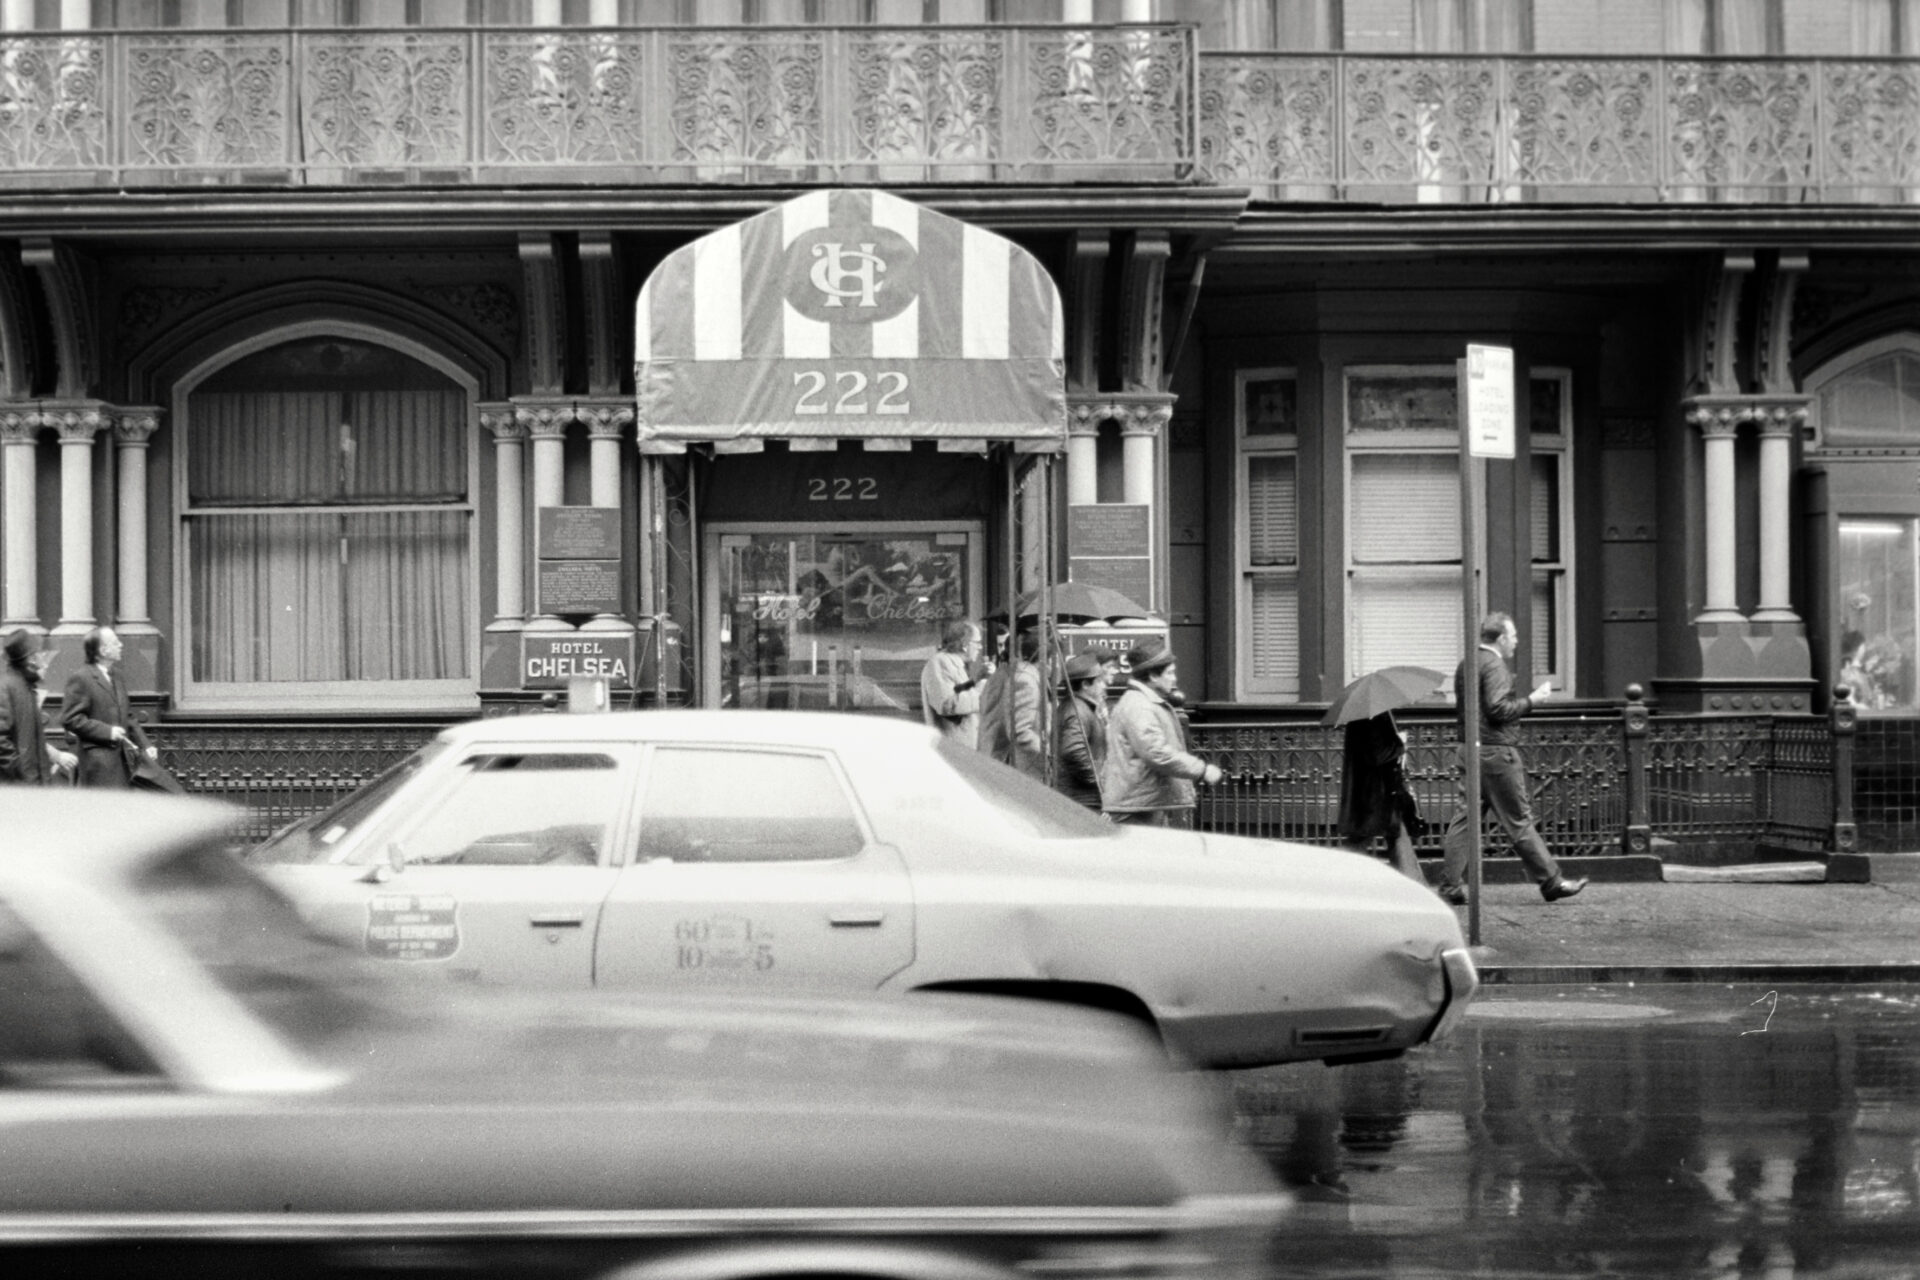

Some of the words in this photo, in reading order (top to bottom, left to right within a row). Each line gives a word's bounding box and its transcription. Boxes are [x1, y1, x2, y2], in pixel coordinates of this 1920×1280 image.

[793, 370, 911, 415] 222
[808, 478, 879, 500] 222
[753, 596, 821, 620] Hotel
[866, 595, 946, 619] Chelsea
[551, 642, 604, 654] HOTEL
[527, 657, 627, 678] CHELSEA
[676, 945, 704, 970] 10
